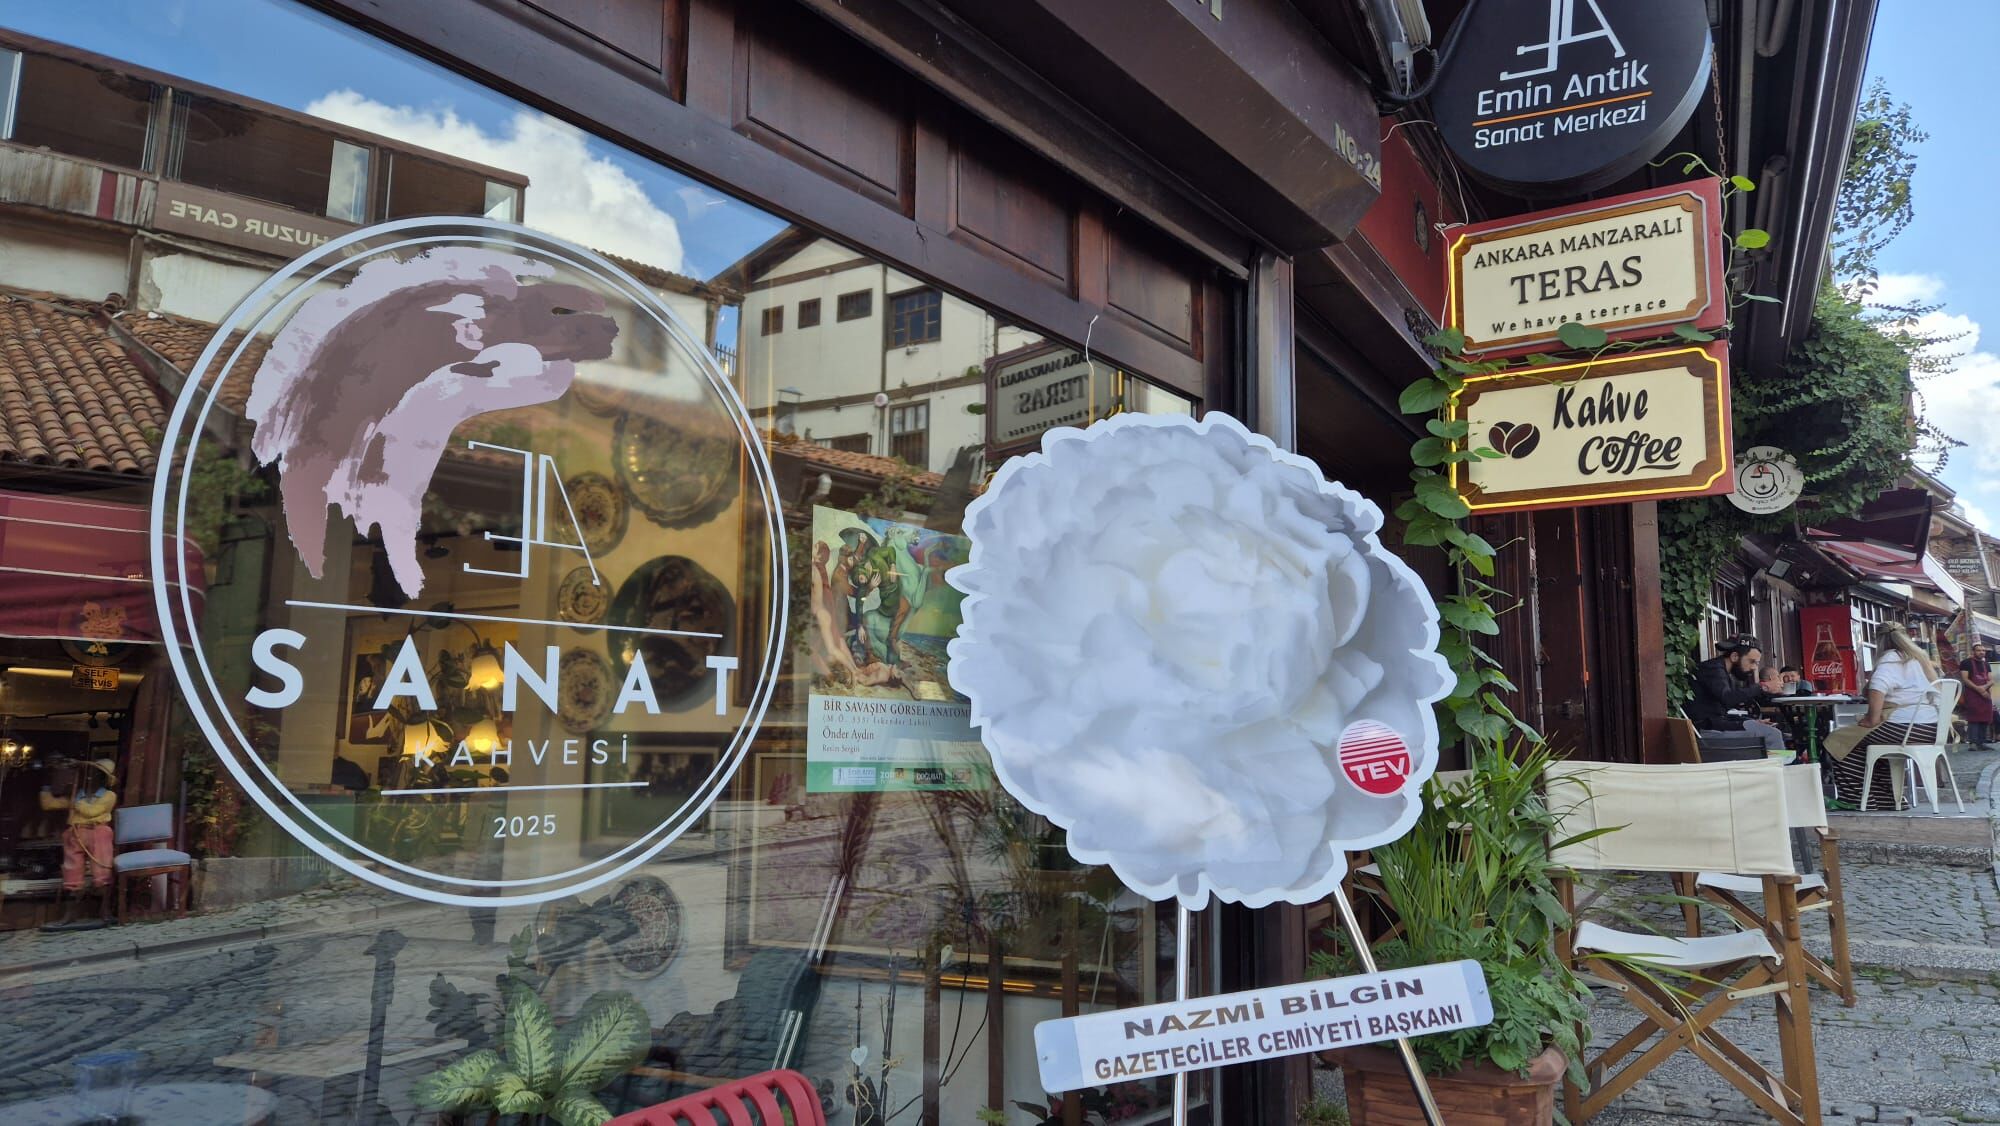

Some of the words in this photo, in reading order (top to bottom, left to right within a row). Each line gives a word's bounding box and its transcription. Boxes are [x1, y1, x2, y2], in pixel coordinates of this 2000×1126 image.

[1477, 81, 1552, 116] Emin
[1563, 60, 1649, 101] Antik
[1474, 121, 1545, 149] Sanat
[1553, 100, 1646, 137] Merkezi
[1474, 241, 1555, 269] ANKARA
[1560, 217, 1683, 254] MANZARALI
[1511, 255, 1643, 304] TERAS
[1492, 321, 1518, 334] We
[1525, 312, 1568, 330] have
[1575, 312, 1583, 322] a
[1590, 298, 1667, 319] terrace
[1553, 381, 1649, 430] Kahve
[1578, 430, 1683, 476] Coffee
[84, 668, 109, 678] SELF
[244, 628, 739, 716] SANAT
[824, 699, 842, 712] BİR
[845, 701, 887, 716] SAVAŞIN
[890, 702, 927, 716] GÖRSEL
[929, 706, 971, 718] ANATOM
[413, 734, 628, 768] KAHVESİ
[822, 726, 848, 739] Önder
[851, 728, 875, 742] Aydın
[1349, 757, 1406, 783] TEV
[493, 813, 557, 839] 2025
[1124, 996, 1264, 1040] NAZMİ
[1280, 977, 1425, 1015] BİLGİN
[1095, 1037, 1253, 1080] GAZETECİLER
[1257, 1016, 1363, 1054] CEMİYETİ
[1369, 1003, 1463, 1037] BAŞKANI
